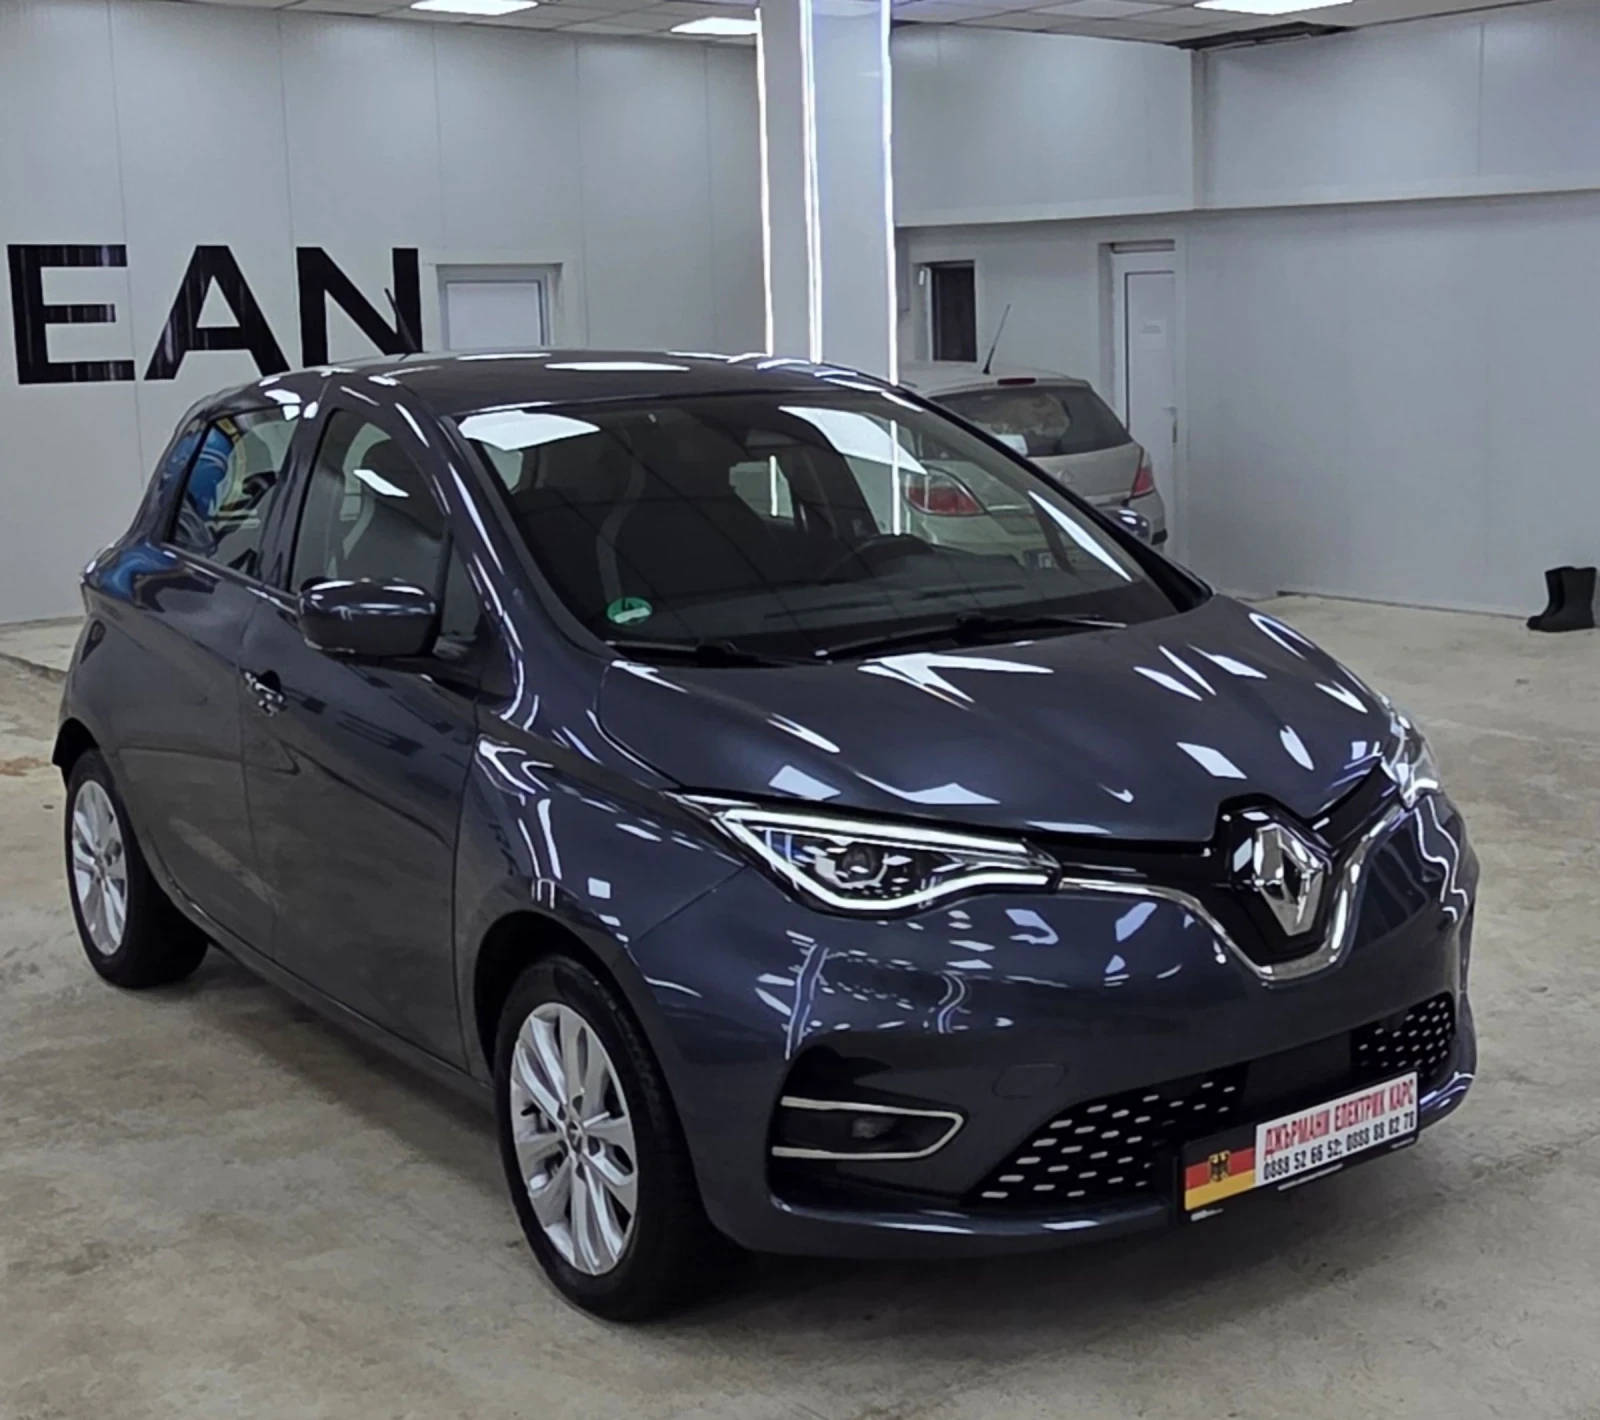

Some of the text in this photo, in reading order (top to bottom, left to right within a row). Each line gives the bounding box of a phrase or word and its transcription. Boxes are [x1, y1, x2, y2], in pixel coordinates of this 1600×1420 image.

[7, 244, 423, 385] EAN
[1264, 1078, 1414, 1160] ДЖЪРМАНИ ЕЛЕКТРИК КАРС
[1294, 1150, 1307, 1170] 52
